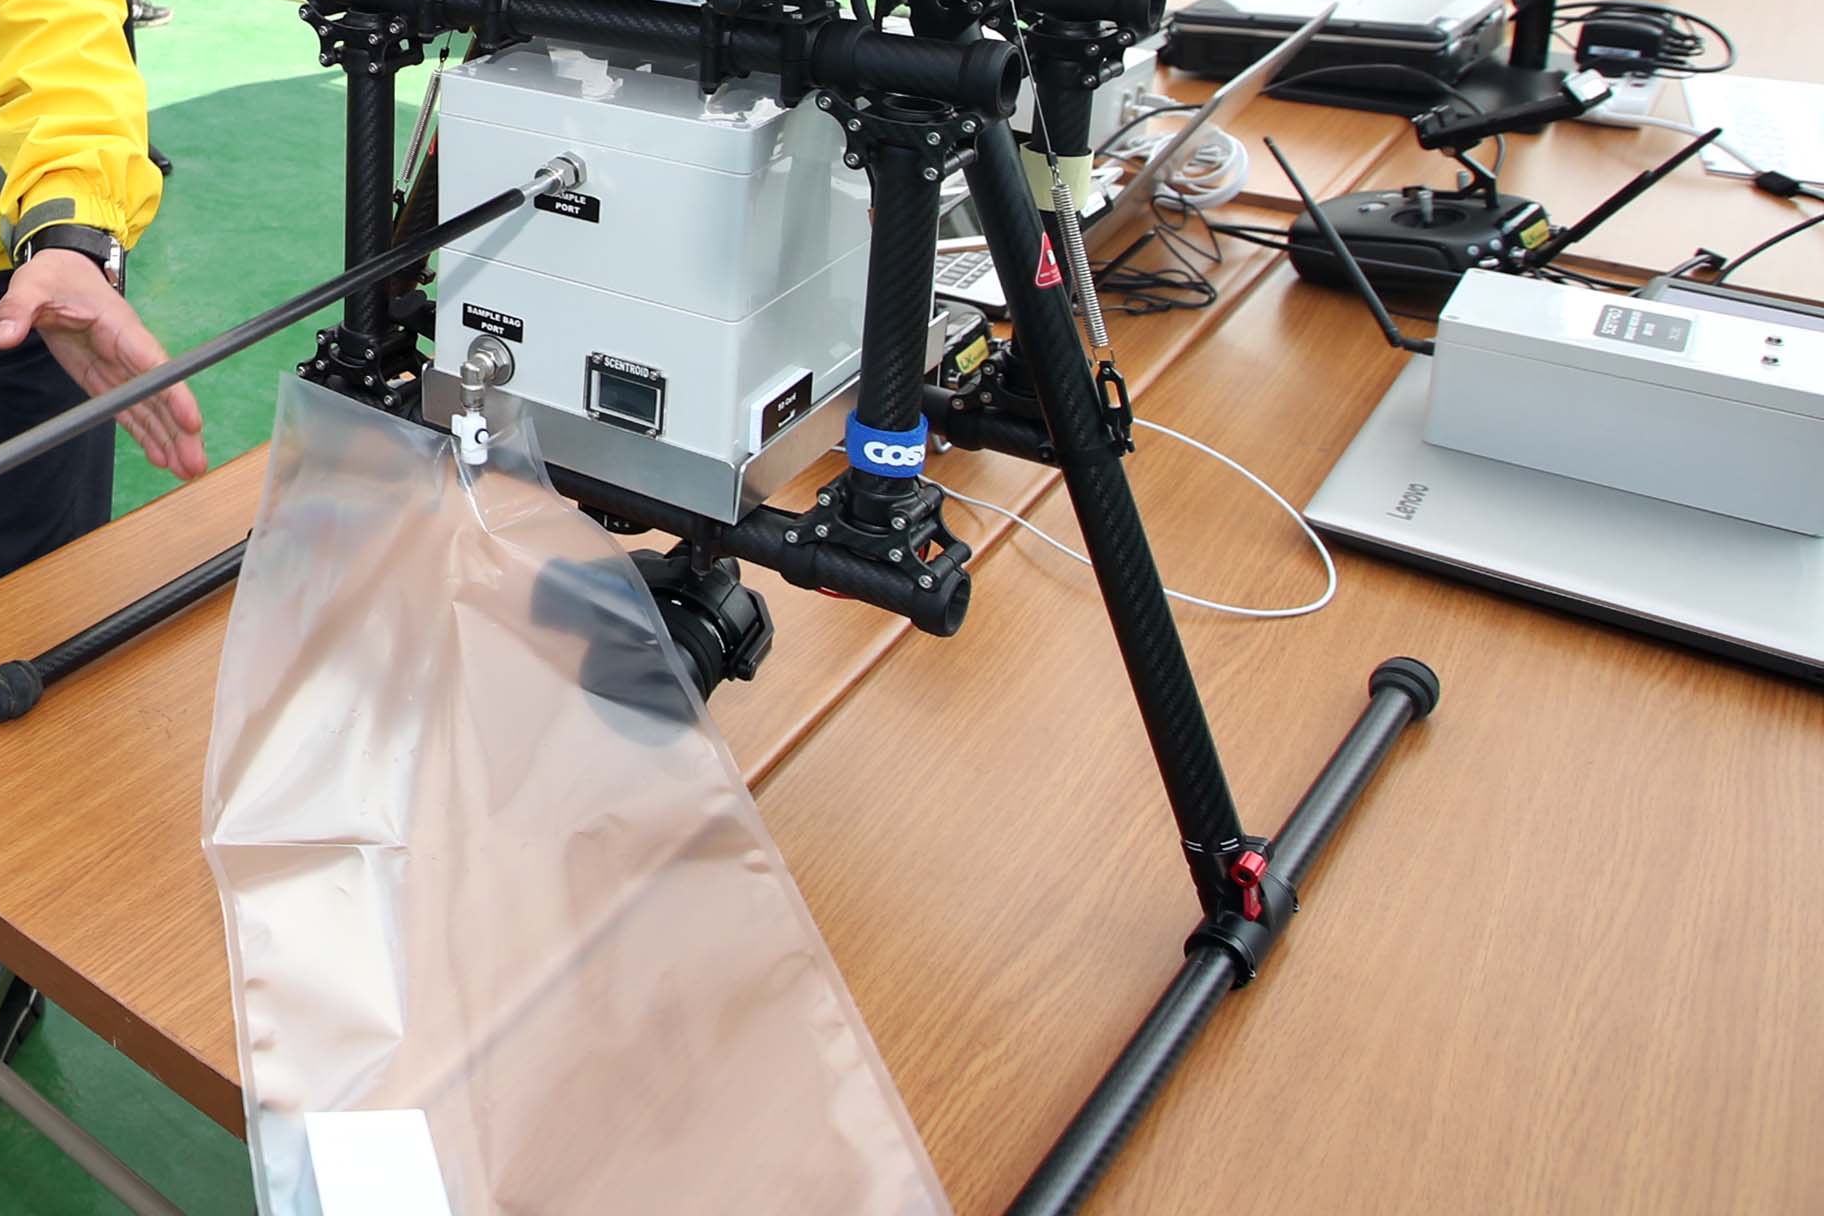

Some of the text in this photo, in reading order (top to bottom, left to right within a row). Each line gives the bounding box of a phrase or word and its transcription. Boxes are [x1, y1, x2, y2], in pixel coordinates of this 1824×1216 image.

[555, 201, 581, 215] PORT
[466, 305, 521, 328] SAMPLE BAG
[480, 322, 505, 335] PORT
[603, 356, 650, 378] SCENTROID
[1385, 483, 1430, 521] Lenovo
